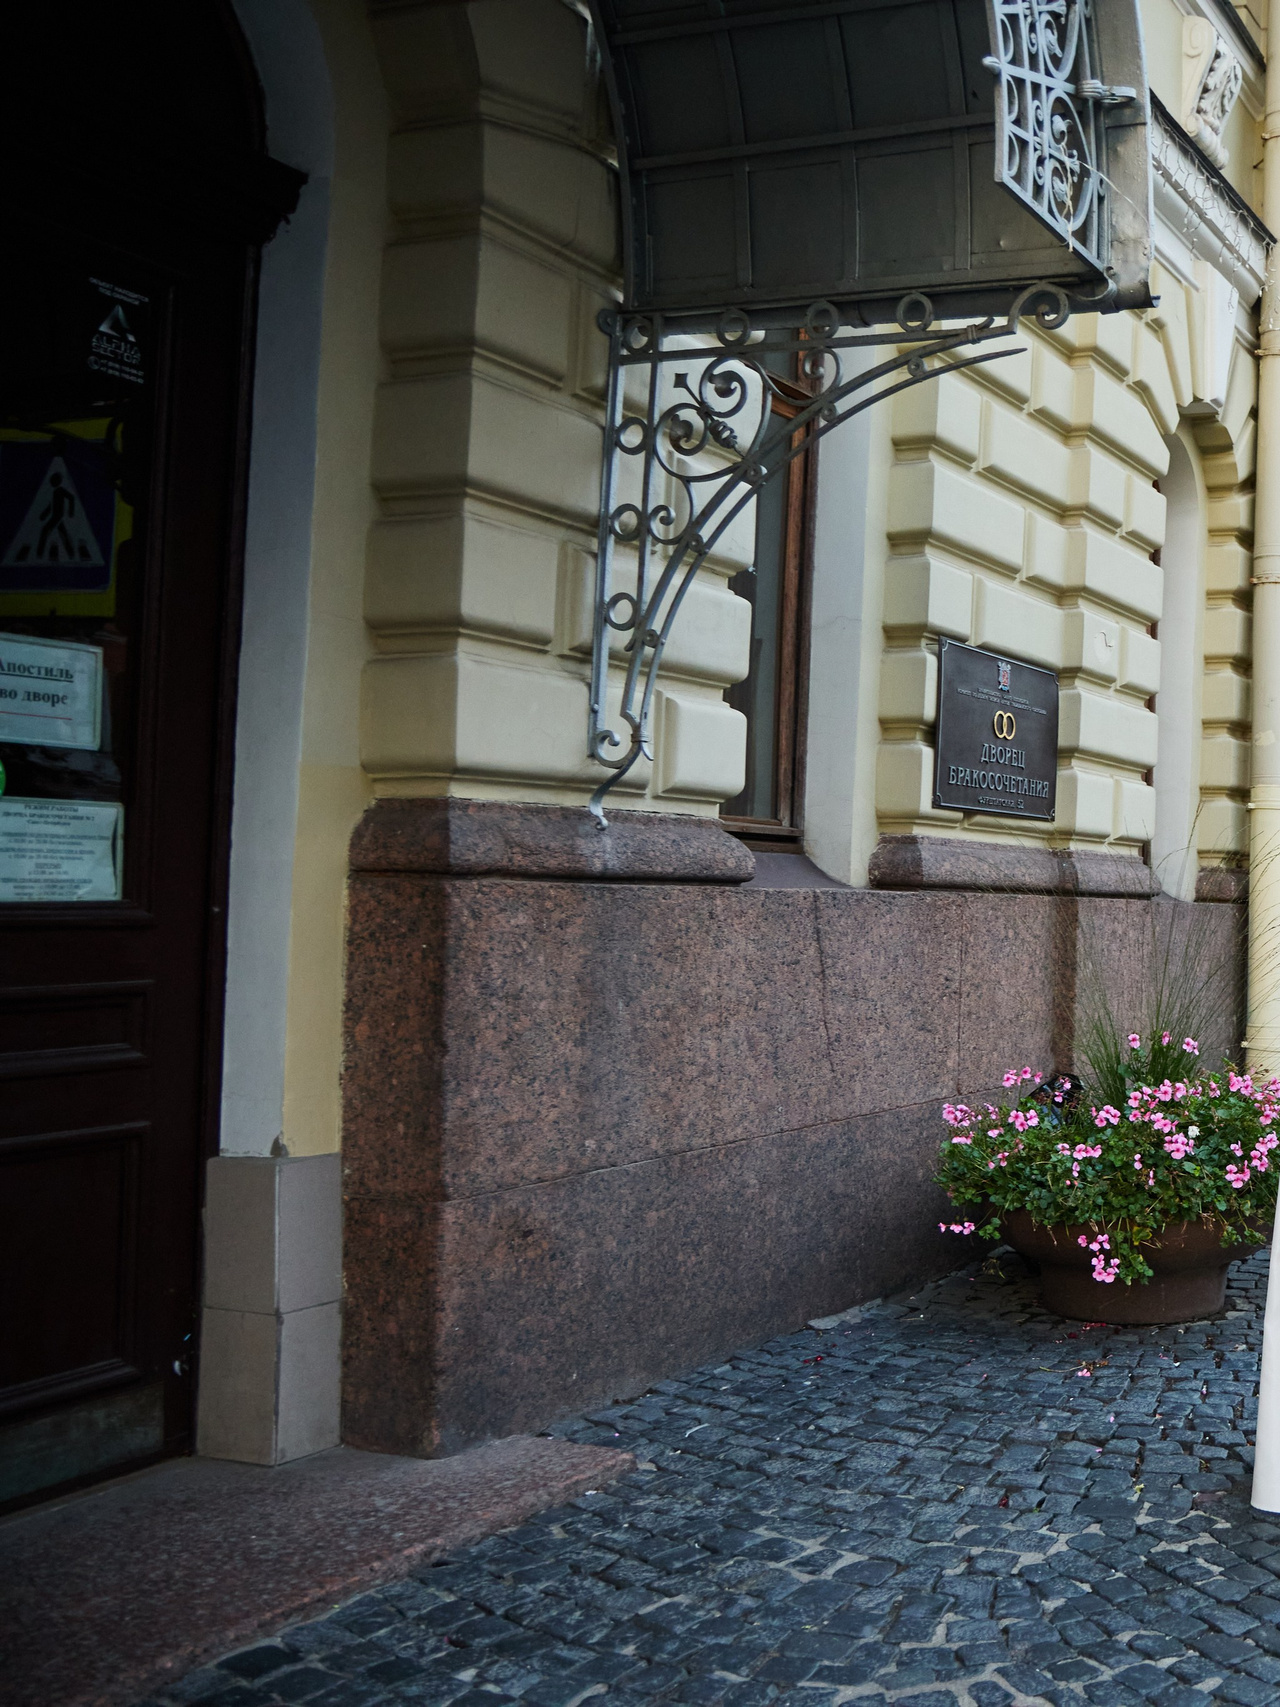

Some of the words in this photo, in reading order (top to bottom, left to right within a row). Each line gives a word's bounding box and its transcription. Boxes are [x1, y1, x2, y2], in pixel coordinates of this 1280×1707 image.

[92, 334, 141, 357] ALPHA
[92, 342, 141, 365] SECTOR
[22, 690, 68, 707] дворе
[980, 743, 1025, 769] ДВОРЕЦ
[948, 766, 1049, 797] БРАКОСОЧЕТАНИЯ
